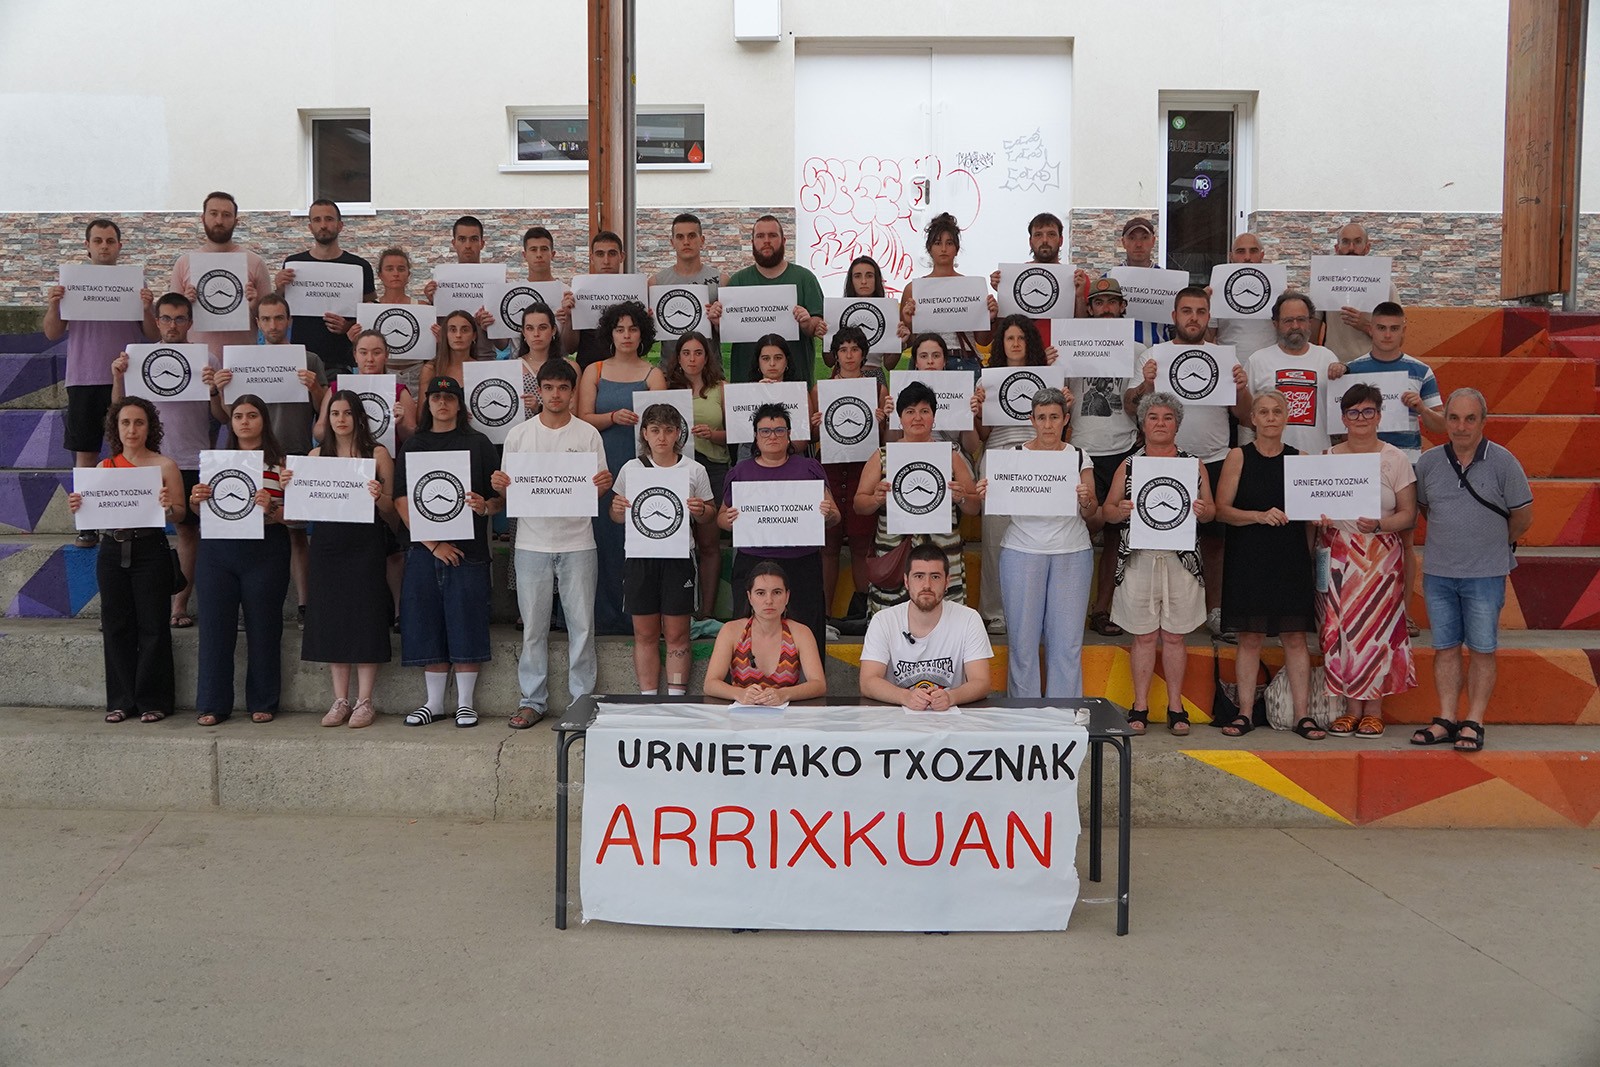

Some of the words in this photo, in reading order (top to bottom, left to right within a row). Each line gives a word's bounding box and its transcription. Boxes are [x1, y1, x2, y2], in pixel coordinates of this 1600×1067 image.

[1317, 275, 1352, 283] URNIETAKO
[66, 284, 104, 292] URNIETAKO
[104, 285, 135, 293] TXOZNAK
[291, 281, 325, 289] URNIETAKO
[436, 282, 470, 290] URNIETAKO
[1331, 285, 1369, 293] ARRIXKUAN!
[1120, 285, 1150, 294] RNIETAKO
[1150, 288, 1178, 297] TXOZNAK
[918, 296, 952, 305] URNIETAKO
[1128, 297, 1165, 306] ARRIXKUAN!
[725, 306, 760, 314] URNIETAKO
[1058, 339, 1094, 347] URNIETAKO
[1094, 339, 1124, 347] TXOZNAK
[1073, 350, 1112, 358] ARRIXKUAN!
[230, 366, 266, 374] URNIETAKO
[266, 365, 297, 373] TXOZNAK
[514, 475, 554, 484] URNIETAKO
[554, 475, 587, 483] TXOZNAK
[994, 473, 1033, 482] URNIETAKO
[1034, 474, 1067, 482] TXOZNAK
[1293, 478, 1334, 487] URNIETAKO
[1334, 477, 1369, 486] TXOZNAK
[293, 479, 331, 488] URNIETAKO
[332, 480, 364, 489] TXOZNAK
[80, 489, 119, 499] URNIETAKO
[531, 487, 573, 495] ARRIXKUAN!
[1010, 485, 1053, 494] ARRIXKUAN!
[1310, 490, 1355, 498] ARRIXKUAN!
[309, 491, 351, 500] ARRIXKUAN!
[98, 500, 140, 508] ARRIXKUAN!
[740, 504, 780, 513] URNIETAKO
[780, 504, 814, 512] TXOZNAK
[757, 516, 800, 524] ARRIXKUAN!
[617, 738, 862, 778] URNIETAKO
[874, 740, 1077, 782] TXOZNAK
[595, 803, 1052, 870] ARRIXKUAN
